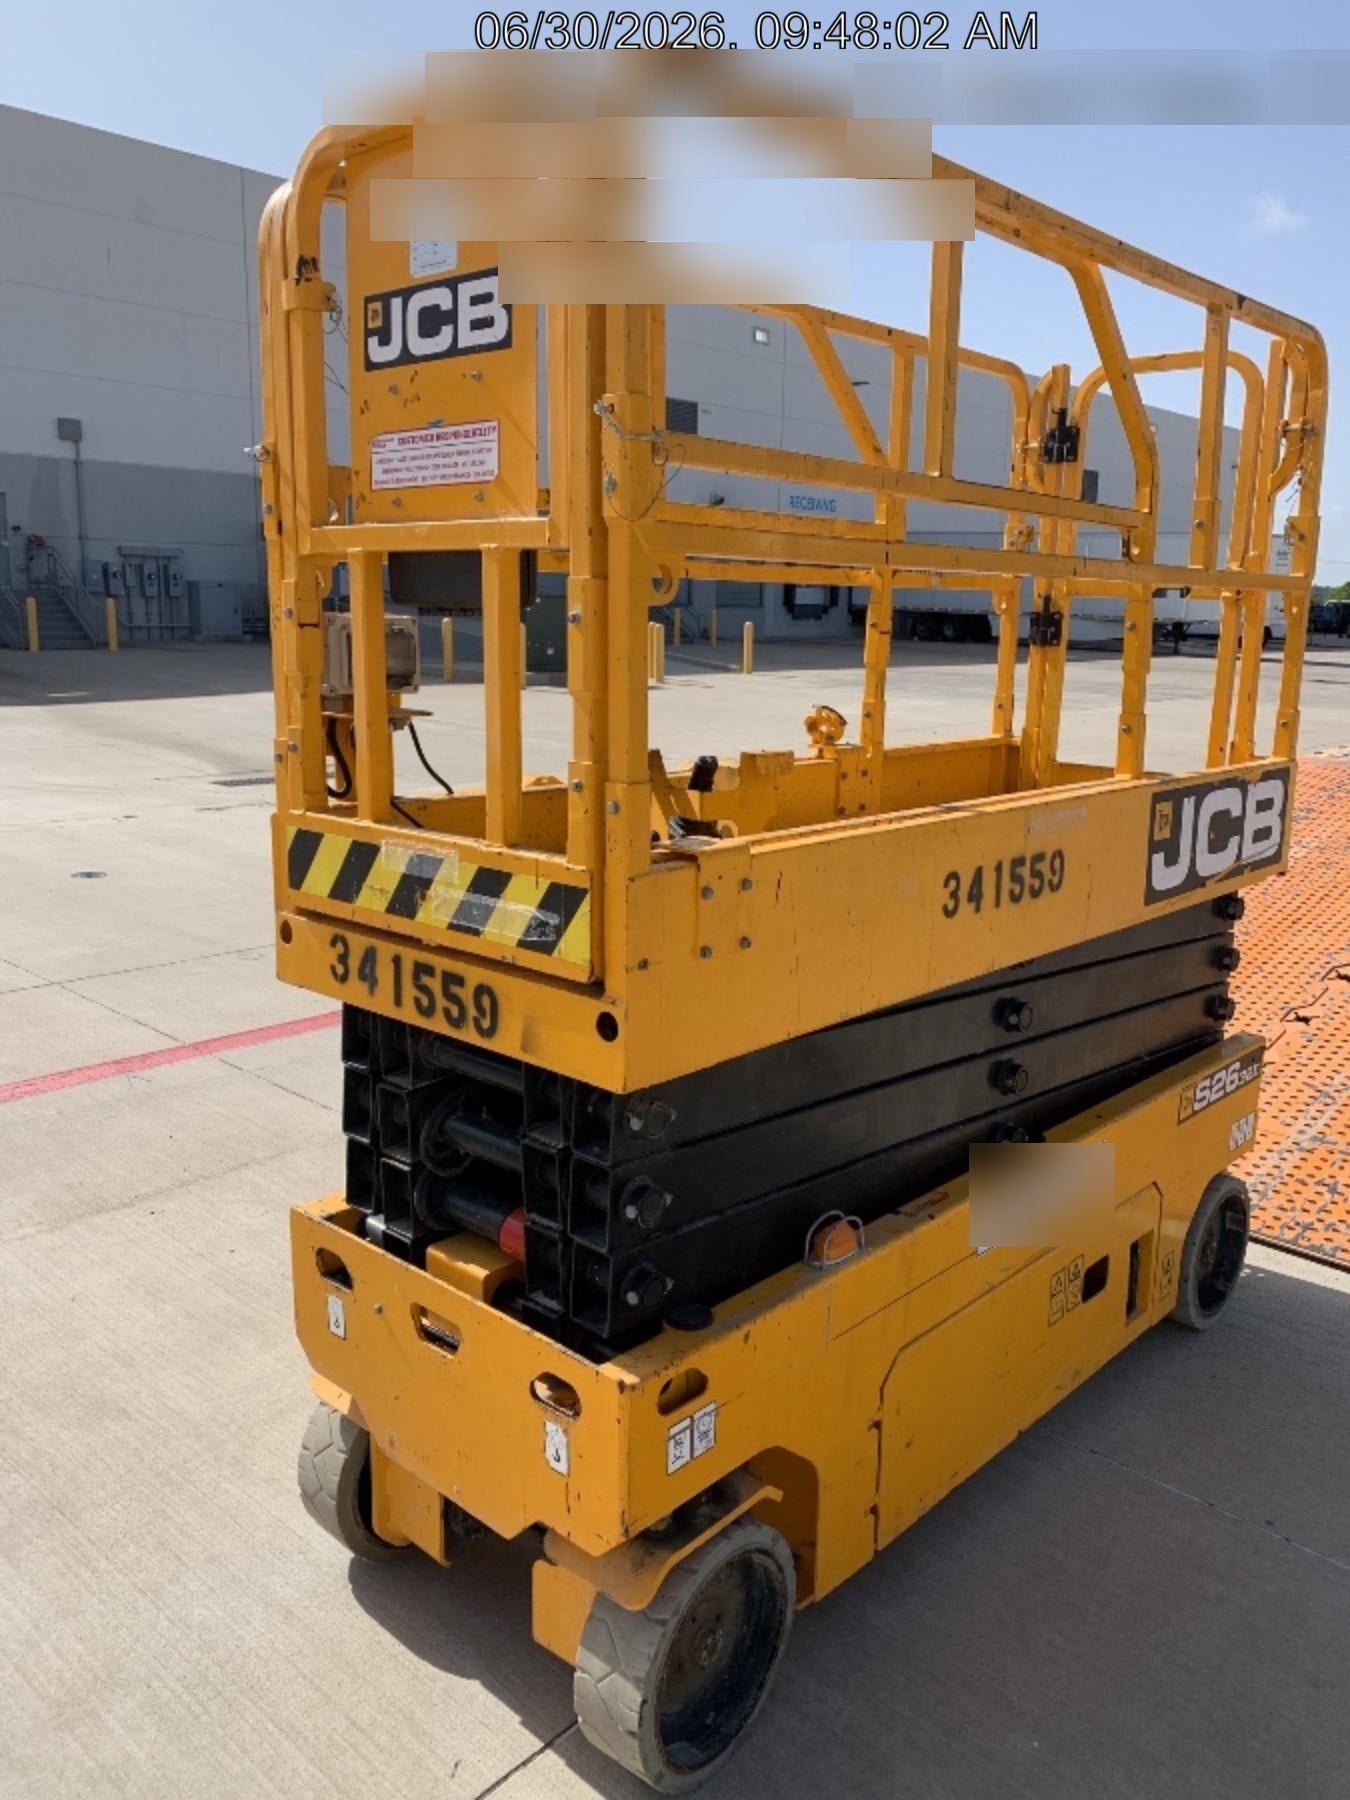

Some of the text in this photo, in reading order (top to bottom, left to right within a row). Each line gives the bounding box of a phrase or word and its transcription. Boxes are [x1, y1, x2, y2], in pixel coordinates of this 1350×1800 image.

[367, 275, 509, 363] JCB
[942, 849, 1065, 918] 341559
[1151, 779, 1285, 891] JCB
[329, 933, 499, 1039] 341559
